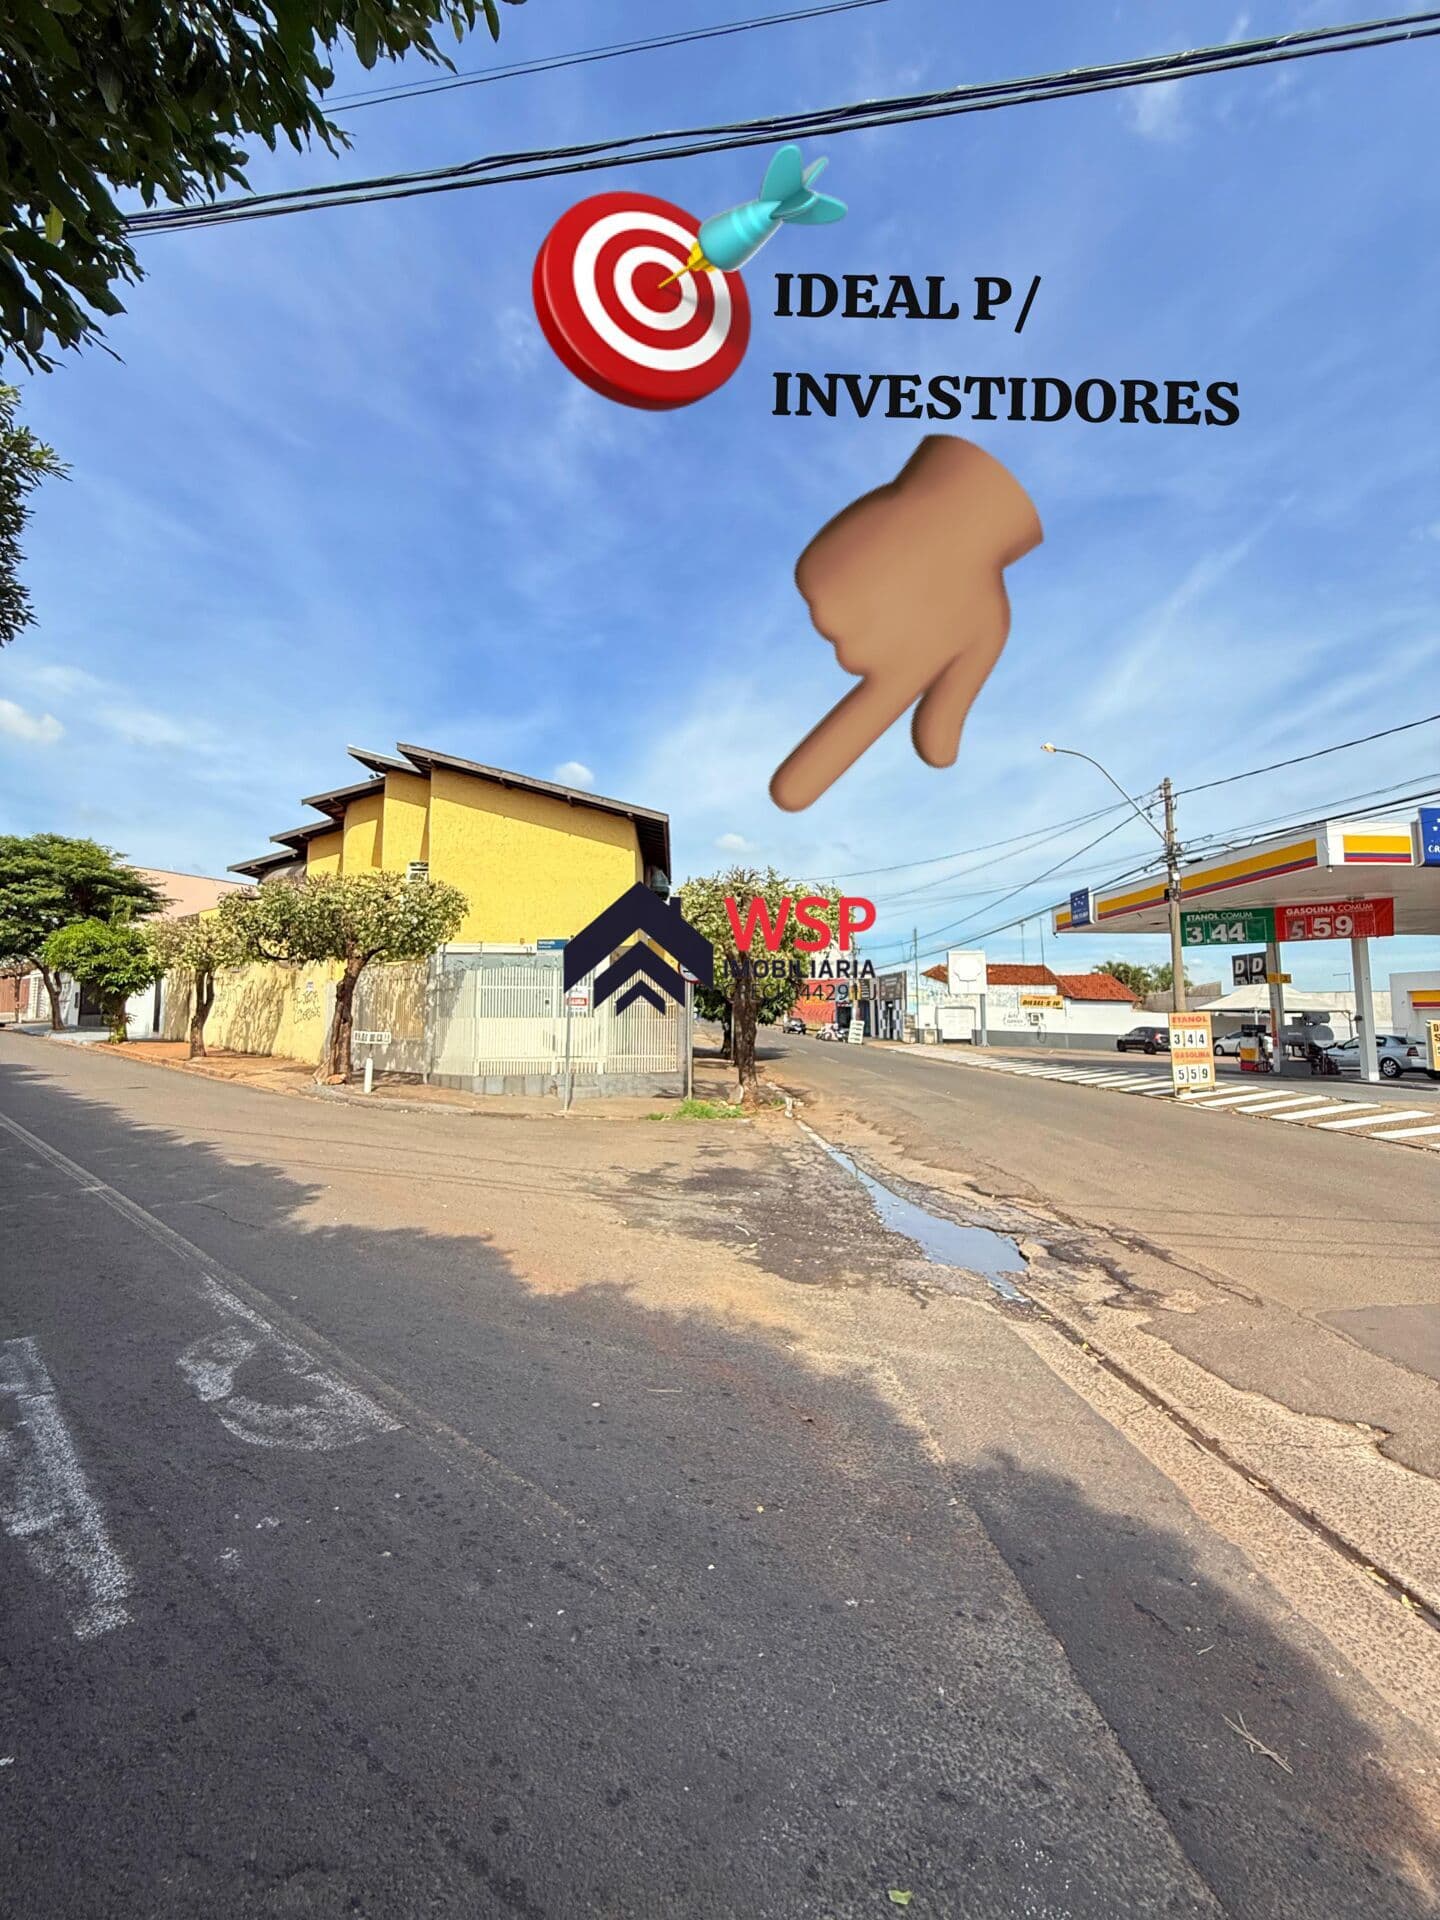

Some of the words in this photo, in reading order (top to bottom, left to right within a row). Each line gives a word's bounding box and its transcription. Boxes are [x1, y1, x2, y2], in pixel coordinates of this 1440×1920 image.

[1285, 905, 1336, 915] GASOLINA
[1337, 903, 1374, 913] COMUM
[1186, 913, 1219, 922] ETANOL
[1220, 911, 1253, 920] COMUM
[1171, 1016, 1208, 1024] ETANOL
[1174, 1051, 1210, 1059] GASOLINA
